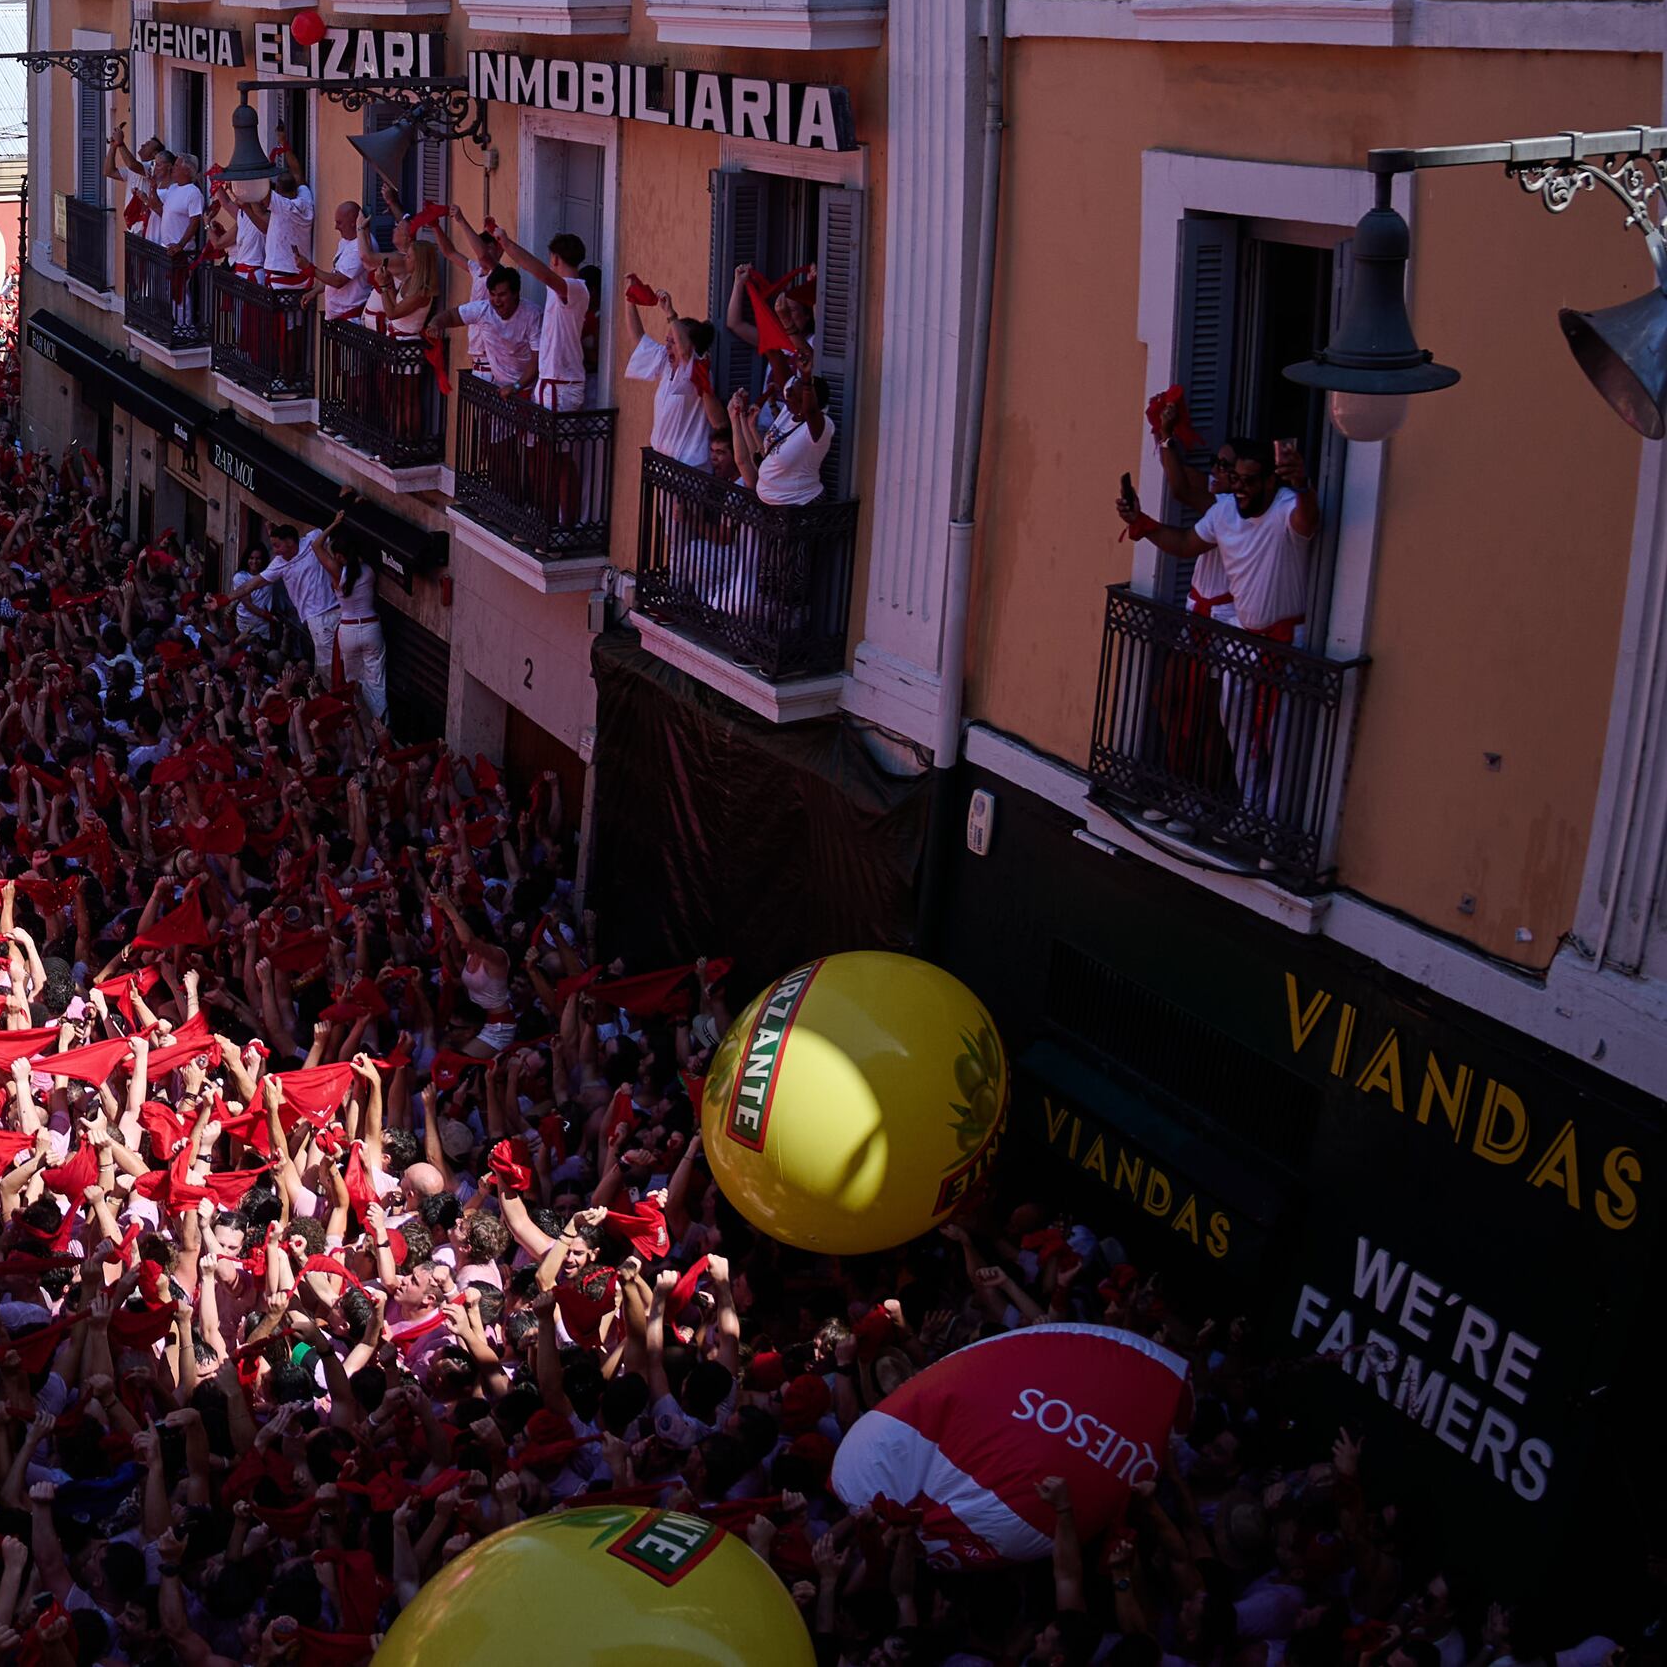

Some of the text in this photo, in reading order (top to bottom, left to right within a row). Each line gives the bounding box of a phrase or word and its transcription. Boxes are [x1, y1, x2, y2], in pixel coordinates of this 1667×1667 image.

[131, 19, 234, 67] AGENCIA
[255, 22, 434, 81] ELIZARI
[467, 50, 841, 152] INMOBILIARIA
[213, 443, 256, 492] BAR MOL
[524, 657, 534, 690] 2
[734, 965, 813, 1133] URZANTE
[1285, 971, 1643, 1231] VIANDAS
[1043, 1096, 1232, 1259] VIANDAS
[1011, 1388, 1159, 1485] QUESOS
[1289, 1283, 1555, 1503] FARMERS
